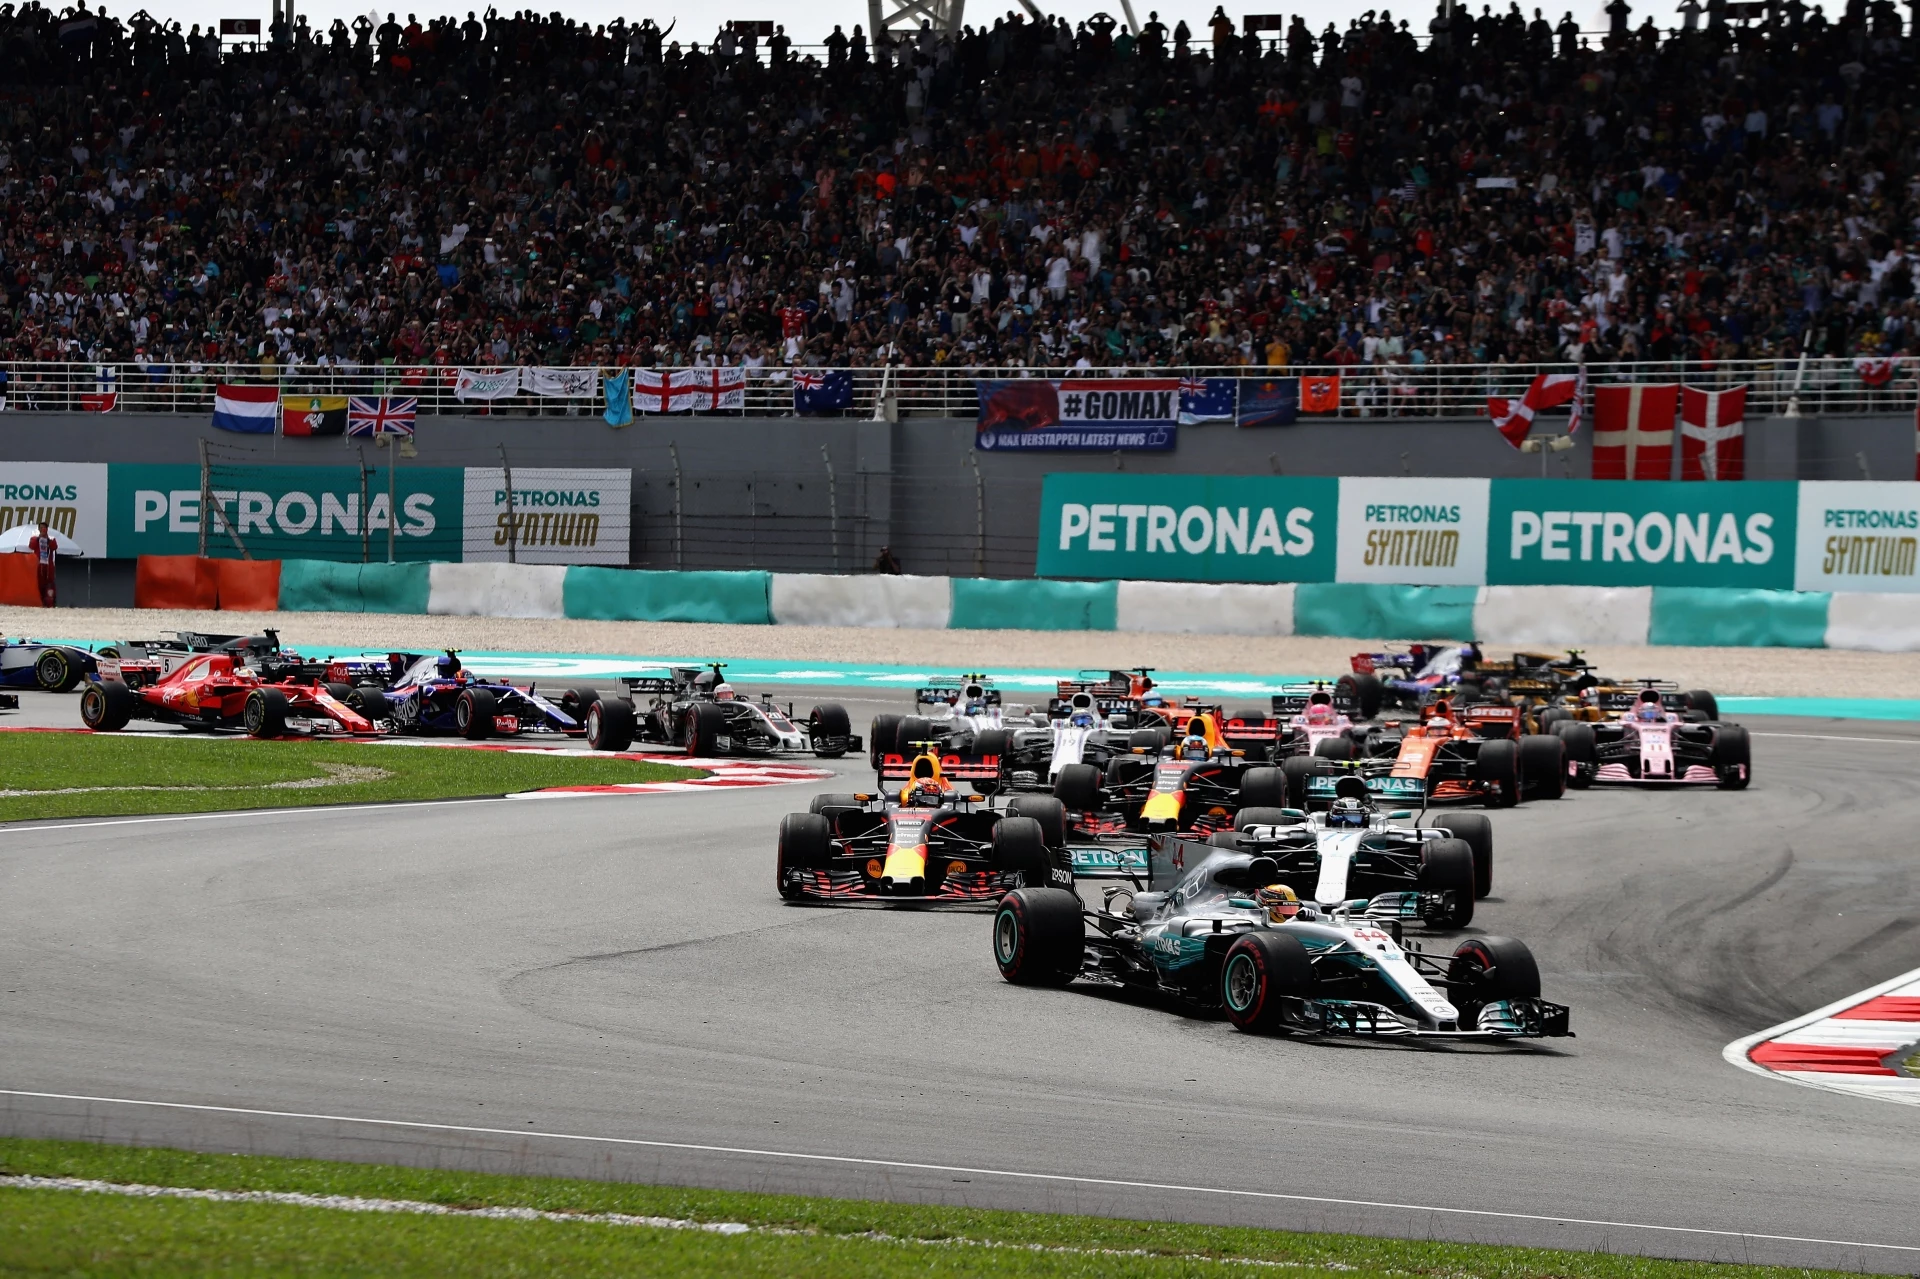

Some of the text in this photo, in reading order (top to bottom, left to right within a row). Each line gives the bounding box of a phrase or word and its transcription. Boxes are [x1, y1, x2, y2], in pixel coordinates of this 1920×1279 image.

[233, 20, 247, 34] G
[1064, 392, 1172, 420] #GOMAX
[999, 432, 1146, 446] MAX VERSTAPPEN LATEST NEWS
[494, 490, 600, 507] PETRONAS
[134, 490, 436, 537] PETRONAS
[1365, 504, 1460, 523] PETRONAS
[1824, 509, 1918, 528] PETRONAS
[494, 512, 600, 547] SYNTIUM
[1059, 503, 1314, 556] PETRONAS
[1511, 511, 1774, 564] PETRONAS
[1363, 529, 1460, 567] SYNTIUM
[1823, 536, 1918, 576] SYNTIUM
[164, 659, 170, 673] 5
[1058, 699, 1134, 709] MTINI
[1314, 776, 1416, 791] PEONAS
[1052, 867, 1073, 885] EPSON
[1353, 930, 1388, 942] 44
